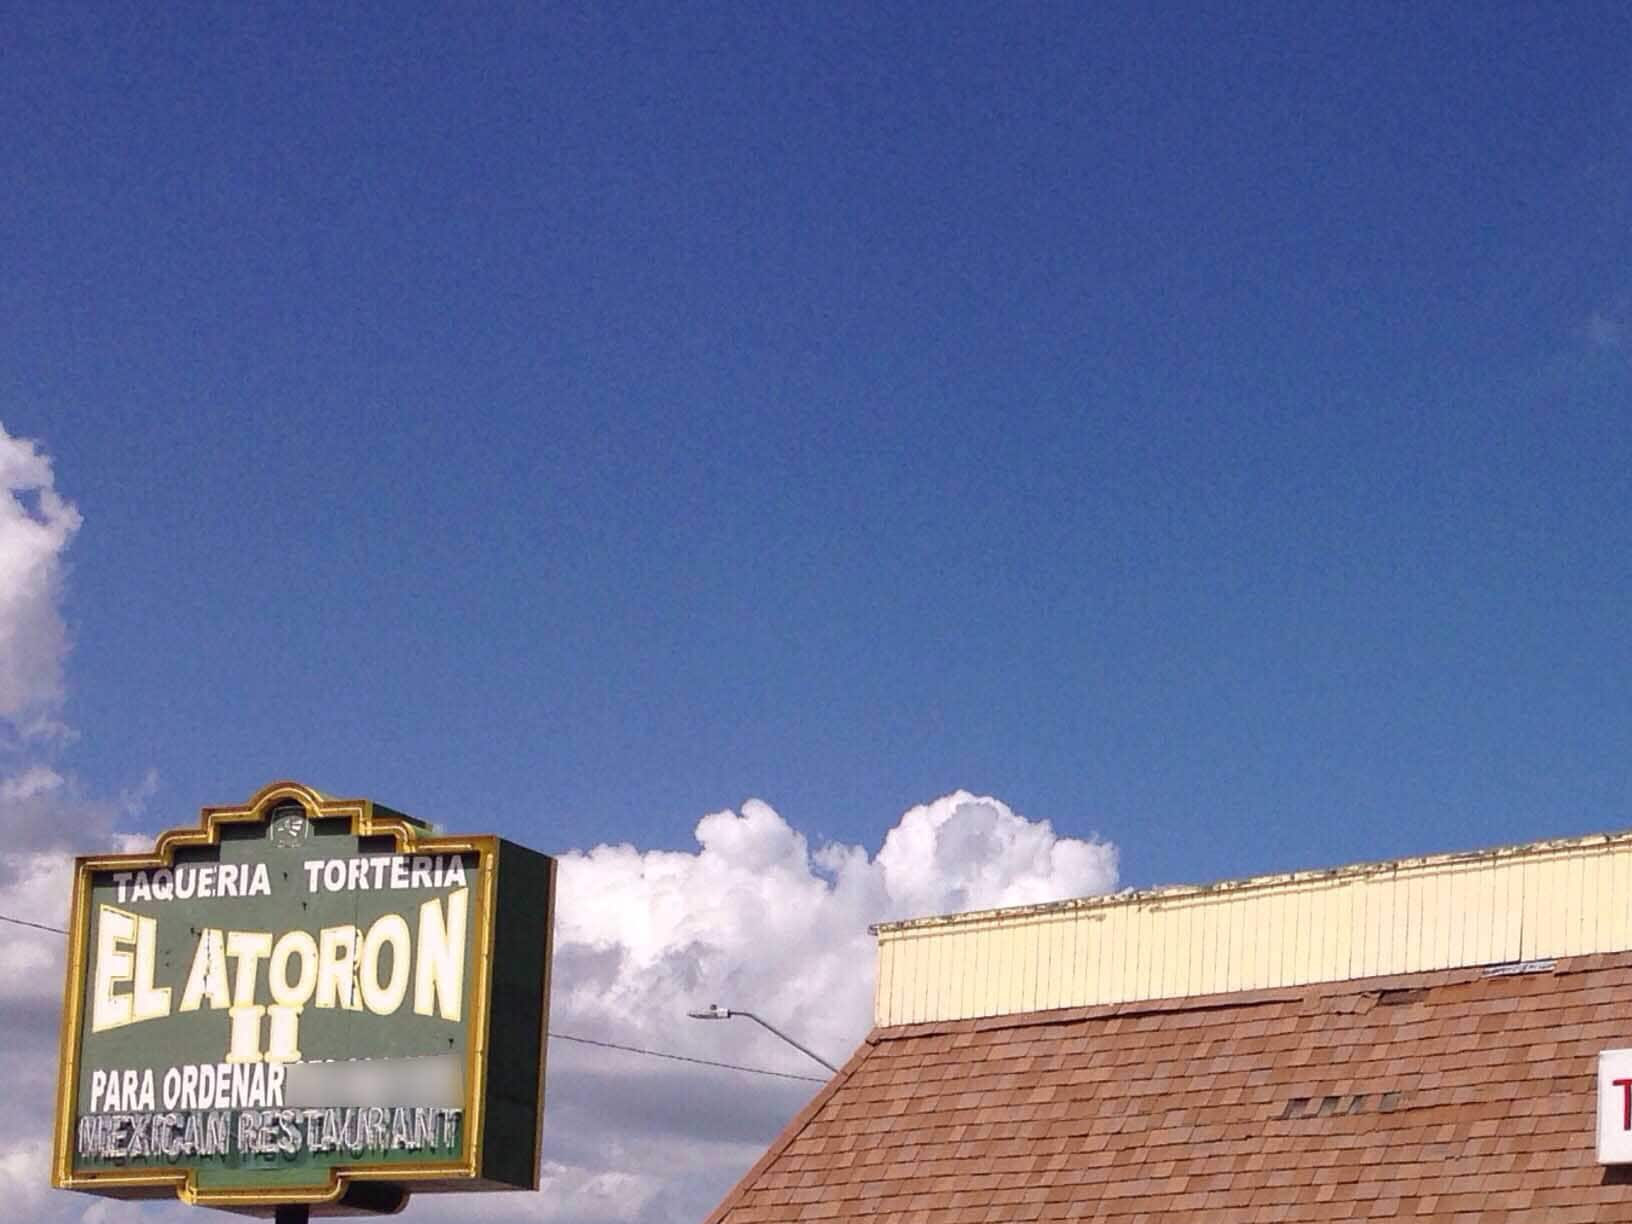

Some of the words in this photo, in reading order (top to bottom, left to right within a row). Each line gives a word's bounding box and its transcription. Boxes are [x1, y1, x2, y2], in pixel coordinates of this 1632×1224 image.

[113, 863, 271, 903] TAQUERIA
[304, 855, 466, 894] TORTERIA
[92, 903, 172, 1032] EL
[179, 888, 469, 1023] ATORON
[90, 1069, 155, 1112] PARA
[163, 1063, 286, 1110] ORDENAR
[78, 1112, 231, 1157] MEXICAN
[238, 1107, 462, 1153] RESTAURANT
